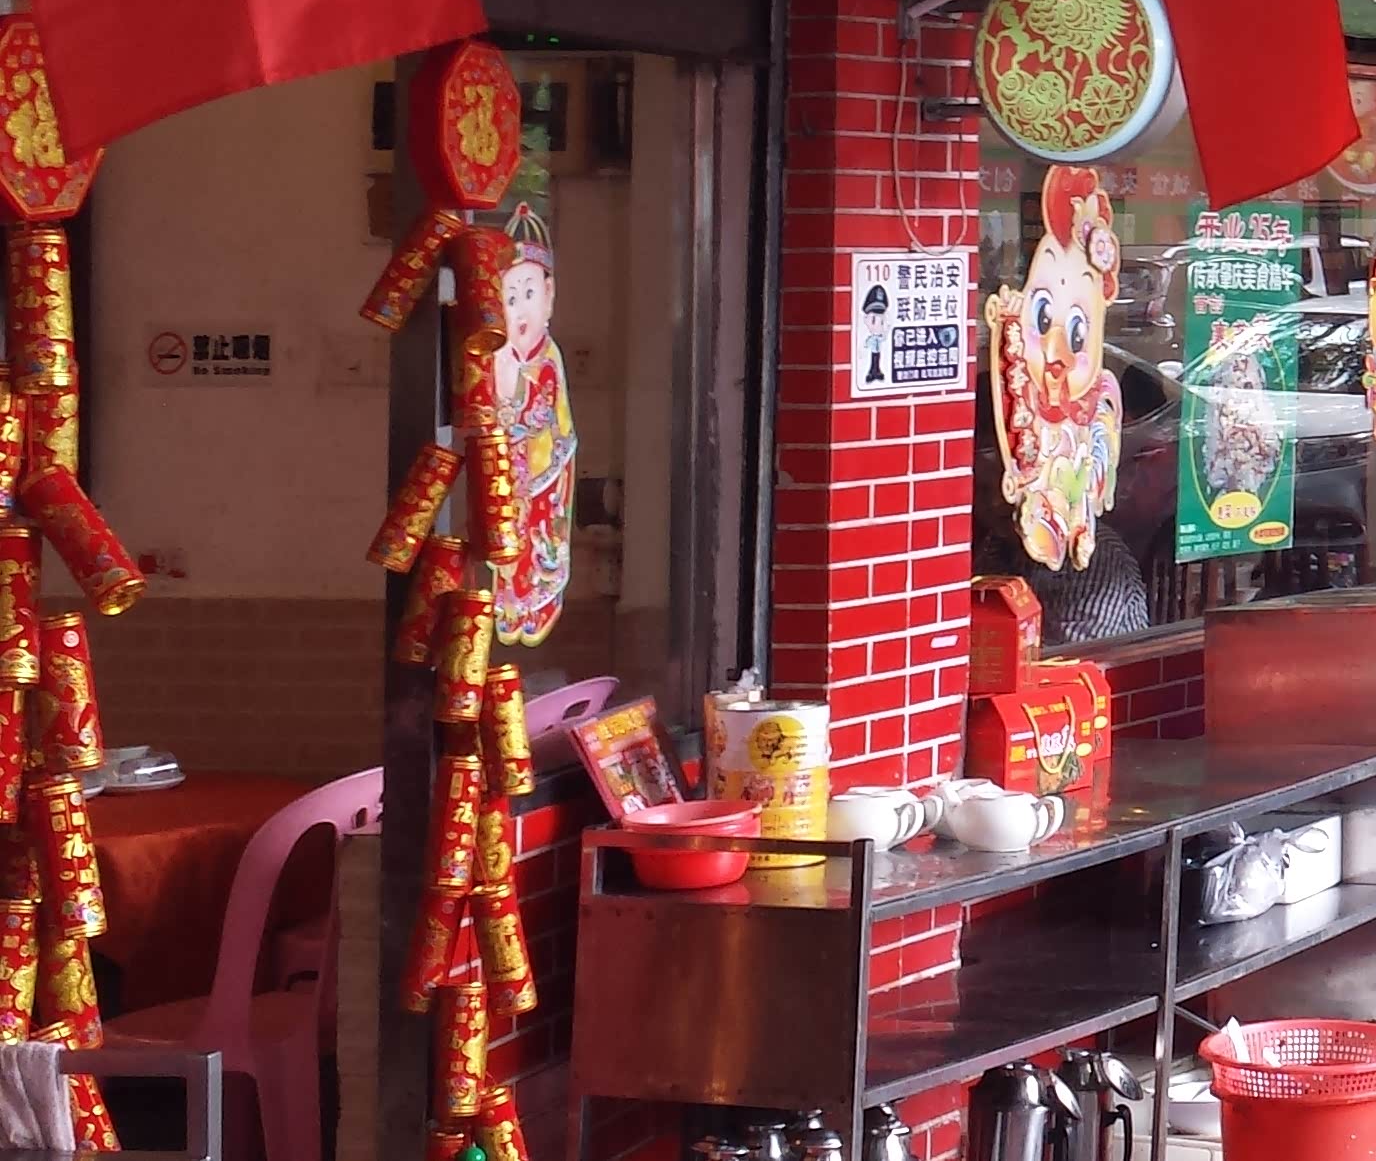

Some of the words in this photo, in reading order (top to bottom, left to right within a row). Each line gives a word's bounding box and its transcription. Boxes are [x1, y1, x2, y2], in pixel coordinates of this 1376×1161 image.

[1195, 212, 1295, 257] 开业25年
[866, 264, 891, 282] 110
[897, 263, 961, 290] 警民治安
[1193, 262, 1295, 291] 传承肇庆美食精华
[896, 295, 959, 322] 联防单位
[894, 328, 938, 347] 你已进入
[894, 347, 959, 369] 视频监控范围
